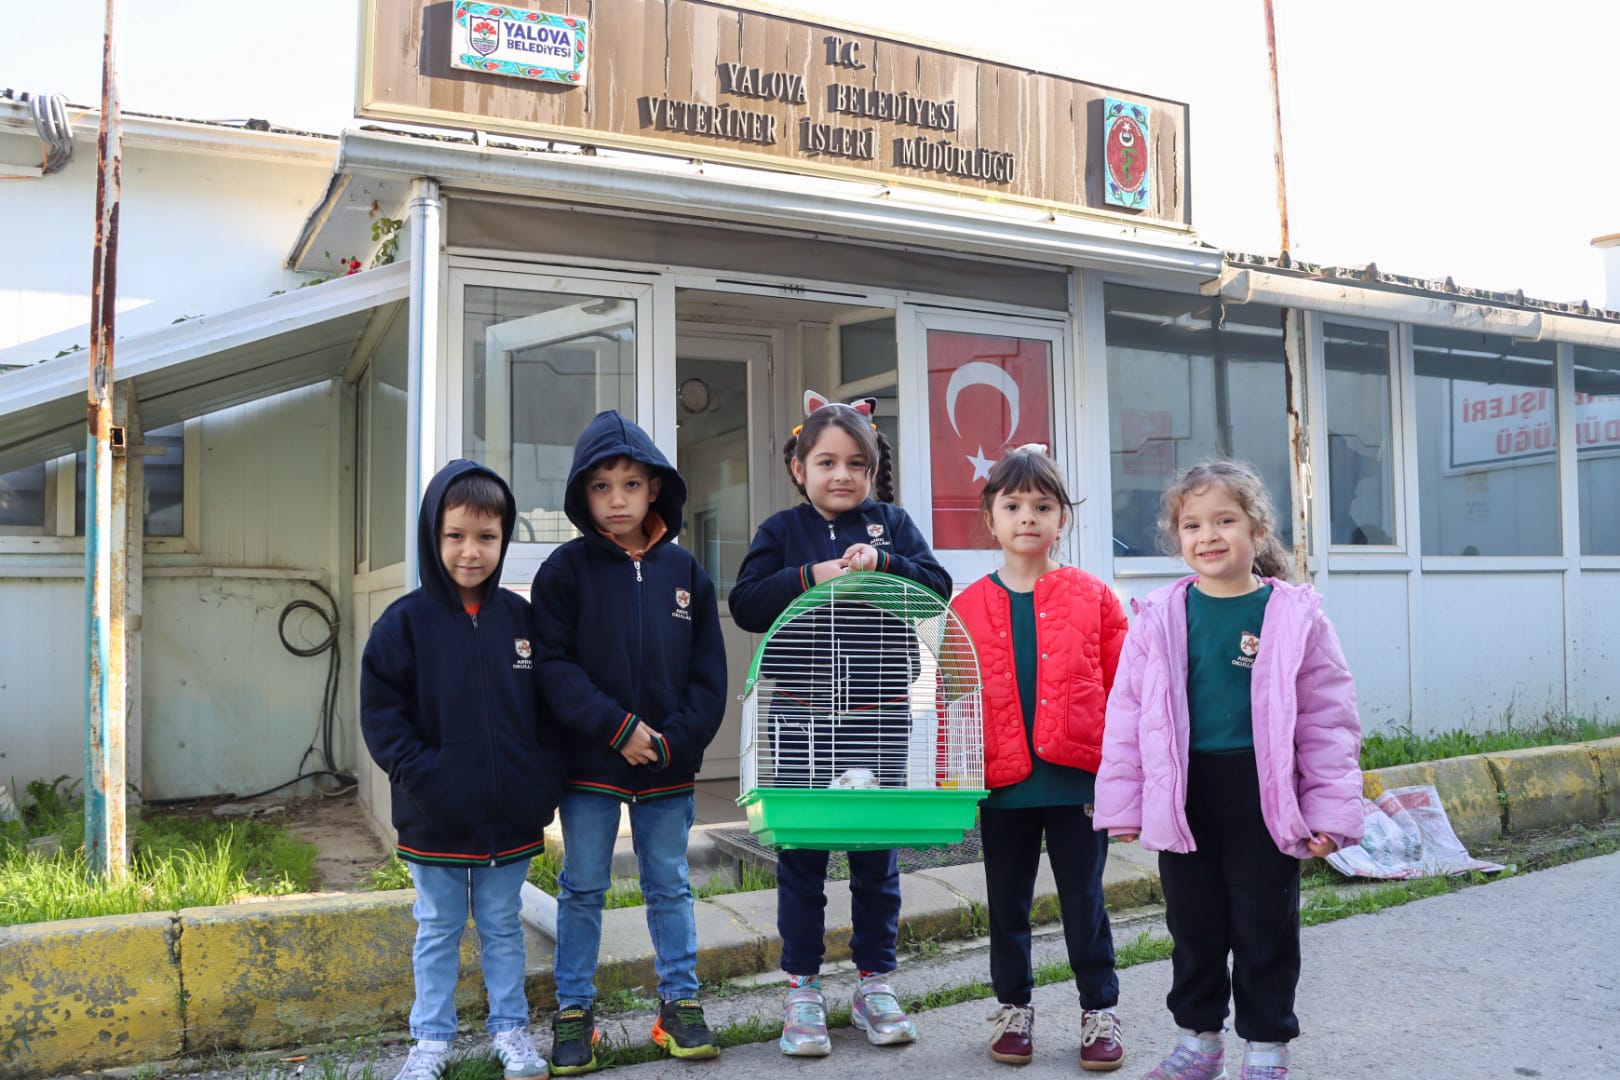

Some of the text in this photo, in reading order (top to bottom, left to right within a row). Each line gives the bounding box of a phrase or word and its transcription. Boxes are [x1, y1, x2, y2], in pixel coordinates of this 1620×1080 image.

[504, 22, 571, 47] YALOVA
[507, 39, 571, 58] BELEDİYESİ
[724, 62, 958, 132] YALOVA BELEDİYESİ
[645, 95, 1016, 184] VETERİNER İŞLERİ MÜDÜRLÜĞÜ
